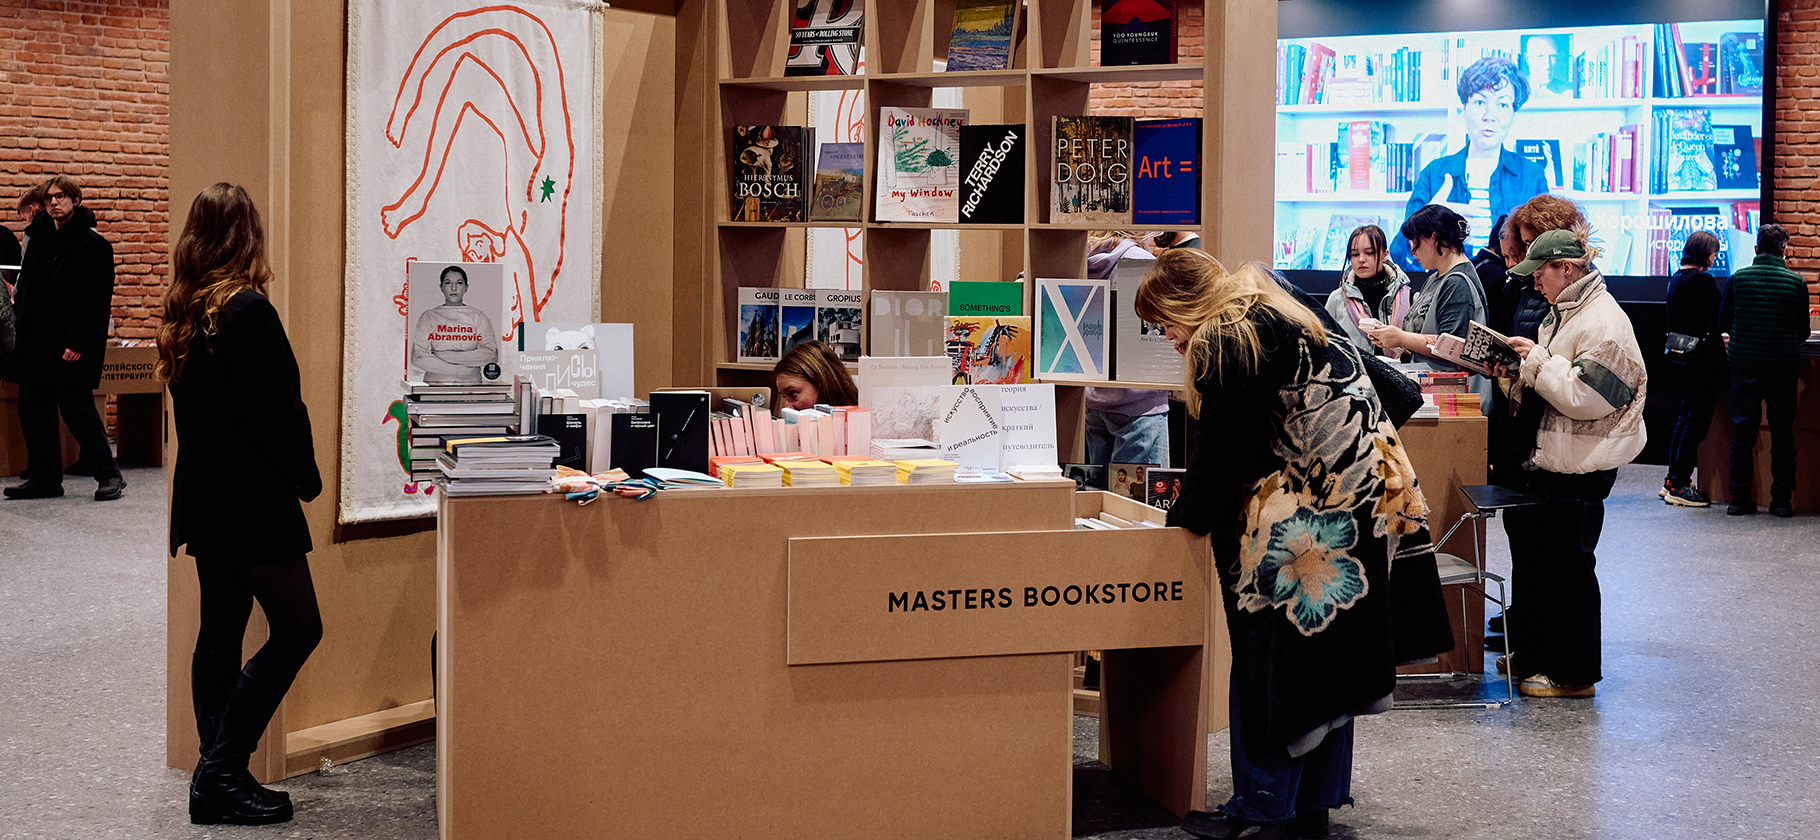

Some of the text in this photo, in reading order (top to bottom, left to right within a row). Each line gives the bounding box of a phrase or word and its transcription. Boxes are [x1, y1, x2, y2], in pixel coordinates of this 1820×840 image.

[819, 29, 838, 37] ROLLING
[838, 29, 854, 37] STONE
[887, 113, 963, 133] David Hockney
[1671, 130, 1705, 140] lexander
[1057, 138, 1128, 159] PETER
[964, 141, 995, 187] TERRY
[1137, 155, 1172, 178] Art
[961, 130, 1018, 218] RICHARDSON
[1057, 162, 1128, 183] DOIG
[739, 182, 798, 198] BOSCH
[910, 186, 953, 198] Window
[1595, 212, 1729, 234] Хорошилова
[754, 291, 779, 300] GAUD
[794, 293, 816, 301] CORB
[826, 294, 862, 303] GROPIUS
[874, 297, 943, 316] DIOR
[959, 303, 1011, 313] SOMETHING'S
[437, 325, 473, 333] Marina
[427, 333, 483, 341] Abramović
[520, 354, 559, 363] Приклю-
[102, 363, 153, 371] ОПЕЙСКОГО
[102, 372, 153, 380] -ПЕТЕРБУРГЕ
[571, 380, 596, 388] чудес
[1001, 386, 1027, 394] теория
[944, 387, 970, 424] искусство
[969, 388, 998, 430] восприятие
[1001, 423, 1034, 432] краткий
[953, 429, 998, 451] реальность
[1002, 443, 1055, 452] путеводитель
[888, 581, 1183, 613] MASTERS BOOKSTORE
